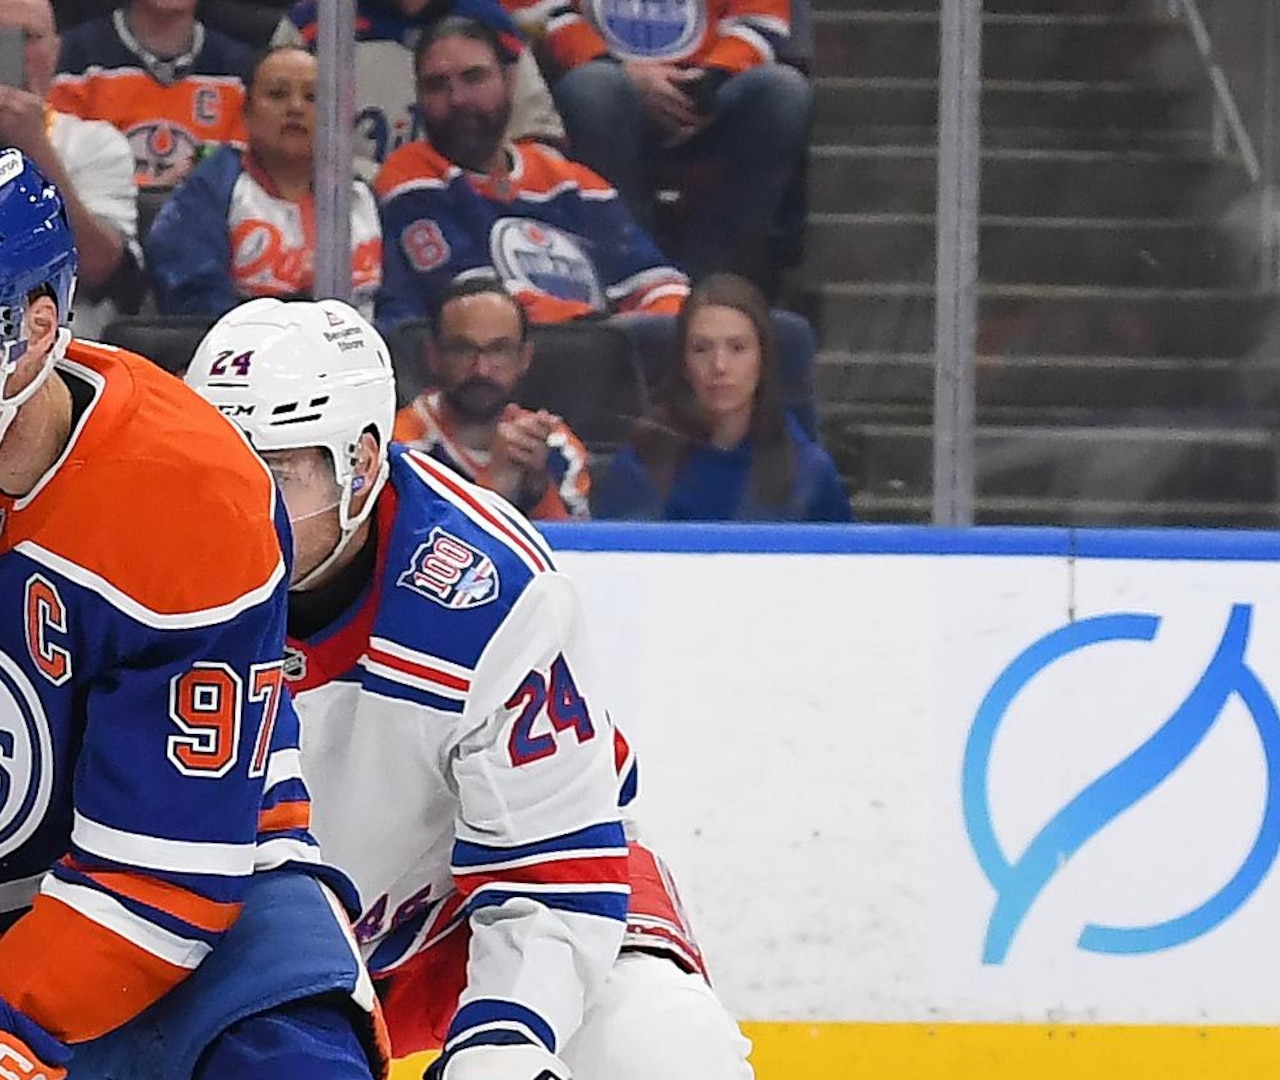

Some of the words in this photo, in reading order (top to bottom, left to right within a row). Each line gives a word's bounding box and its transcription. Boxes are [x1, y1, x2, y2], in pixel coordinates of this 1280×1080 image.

[192, 86, 222, 125] C
[208, 349, 256, 377] 24
[412, 537, 475, 600] 100
[23, 572, 73, 687] C
[167, 660, 286, 779] 97
[503, 650, 596, 768] 24
